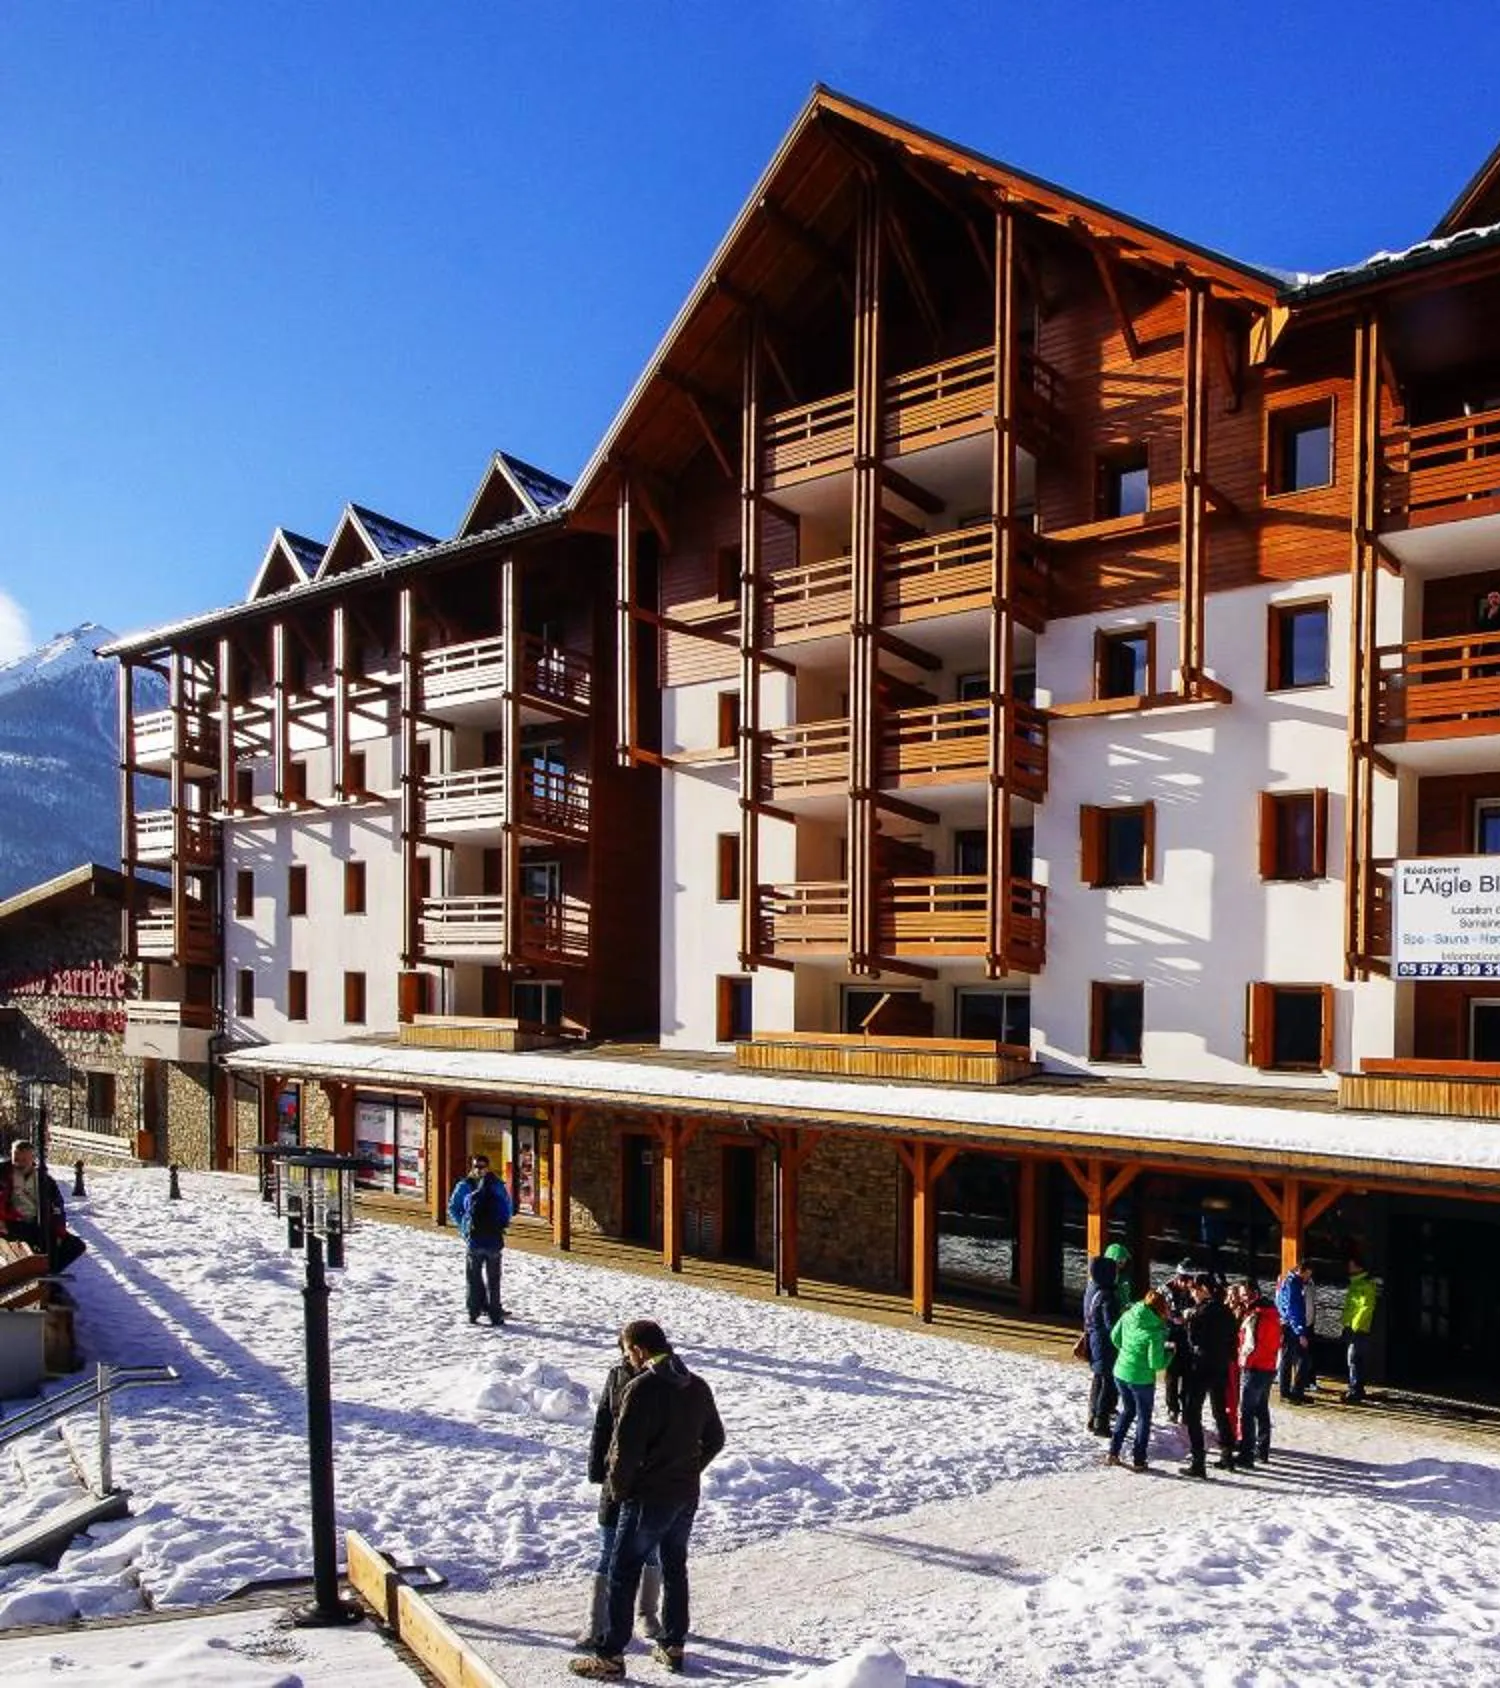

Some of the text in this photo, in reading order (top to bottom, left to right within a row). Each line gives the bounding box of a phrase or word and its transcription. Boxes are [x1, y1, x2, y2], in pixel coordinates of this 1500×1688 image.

[1403, 877, 1471, 898] L'Aigle
[1451, 905, 1492, 915] Location
[1434, 933, 1469, 944] Sauna
[1399, 963, 1417, 975] 05
[1420, 963, 1438, 975] 57
[1462, 963, 1481, 975] 99
